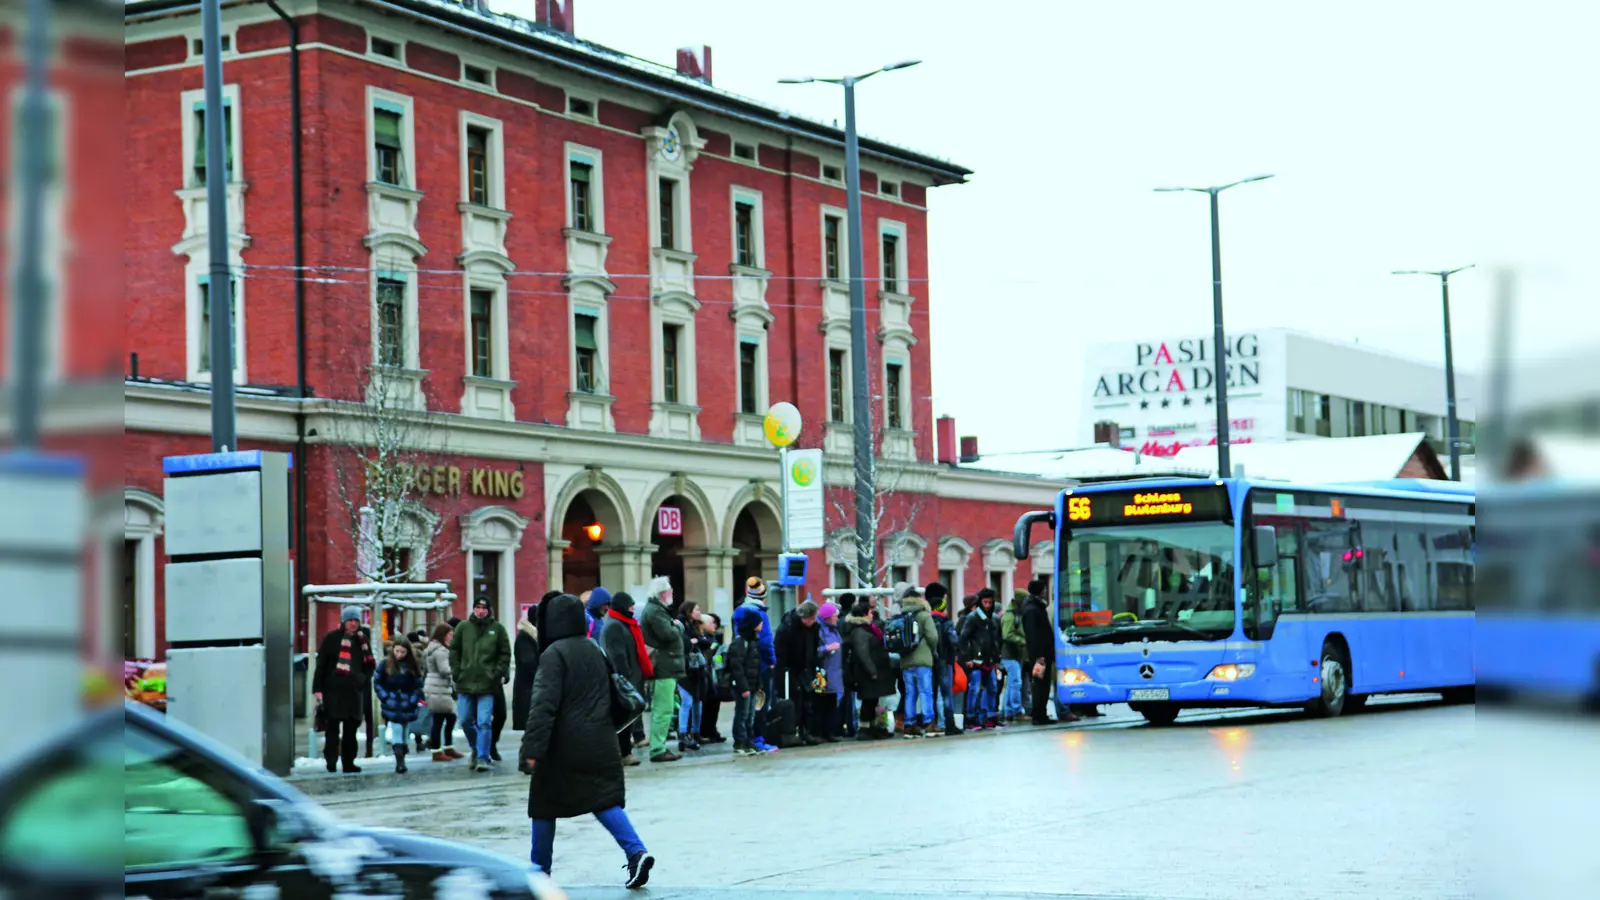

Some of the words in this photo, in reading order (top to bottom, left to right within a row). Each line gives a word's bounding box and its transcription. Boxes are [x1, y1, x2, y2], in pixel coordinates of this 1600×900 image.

[1136, 333, 1258, 366] PASING
[1093, 361, 1260, 397] ARCADEN
[472, 468, 524, 498] KING
[1069, 497, 1091, 520] 56
[1124, 503, 1192, 516] Blutenburg
[1134, 493, 1181, 504] Schloss
[661, 509, 679, 530] DB
